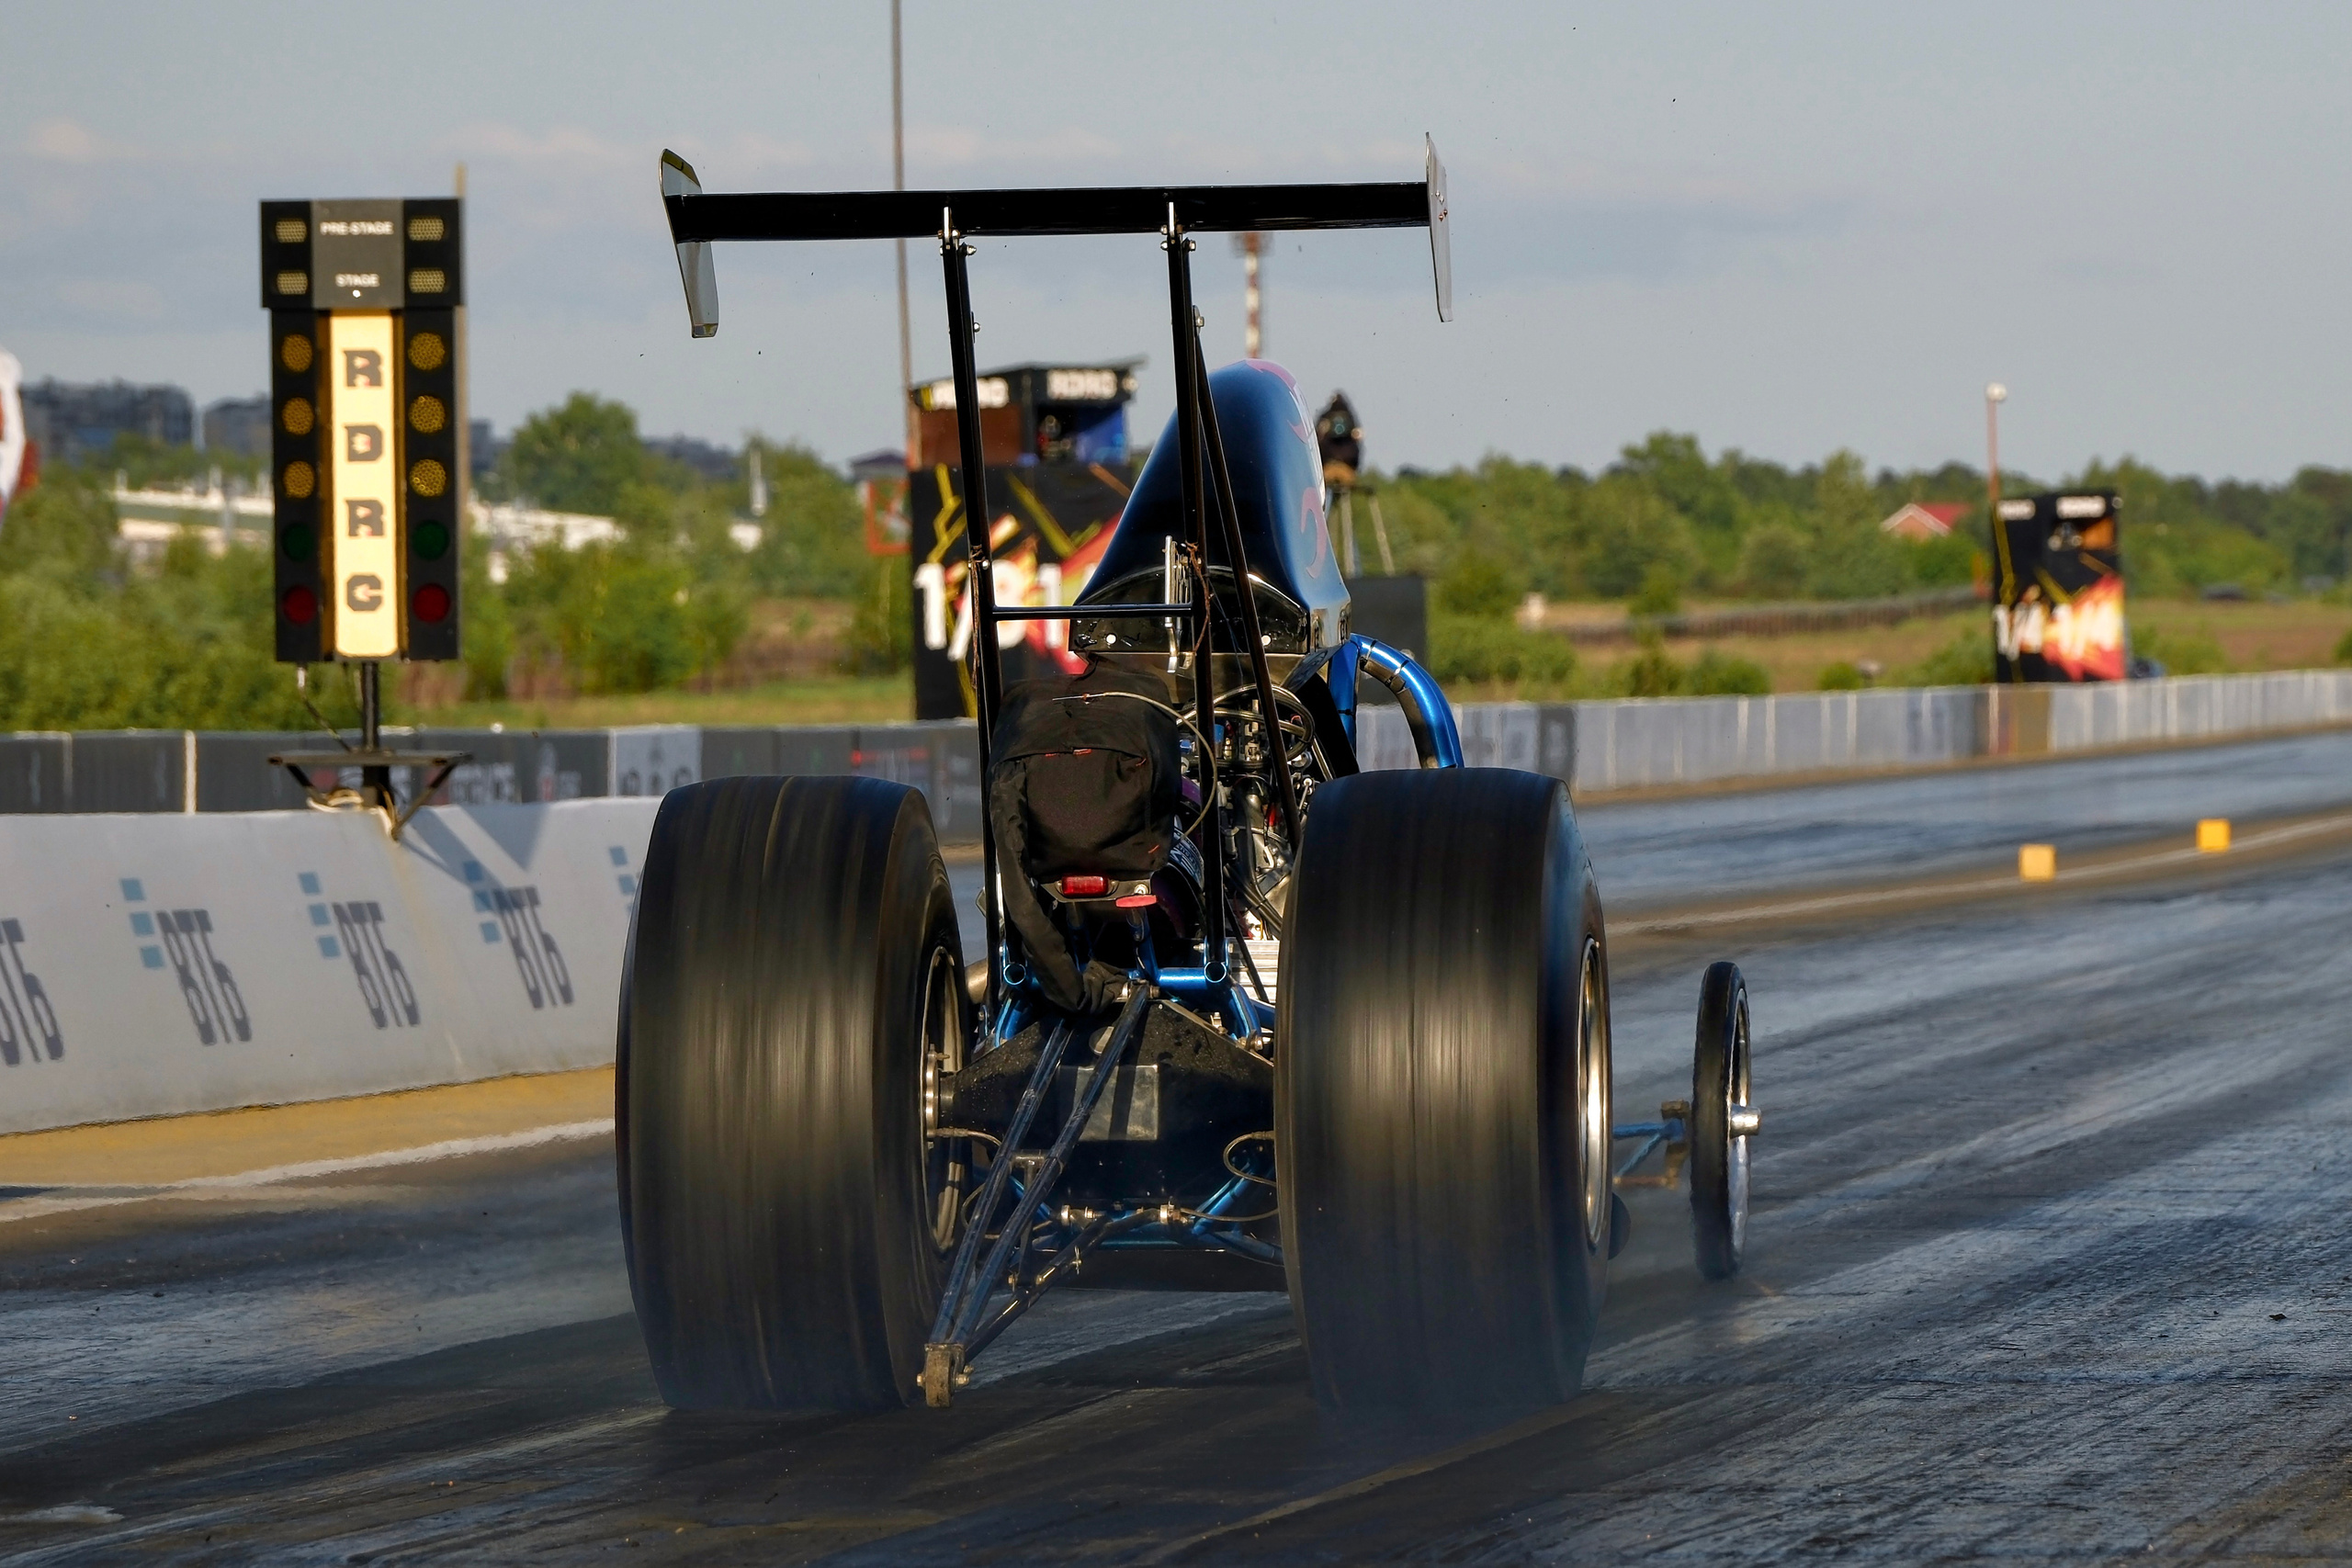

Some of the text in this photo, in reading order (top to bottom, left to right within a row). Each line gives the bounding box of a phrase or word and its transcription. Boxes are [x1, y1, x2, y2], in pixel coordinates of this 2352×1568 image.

[335, 274, 380, 288] STAGE
[343, 349, 384, 613] RDRC
[156, 908, 252, 1045] ВТБ
[332, 901, 420, 1029] ВТБ
